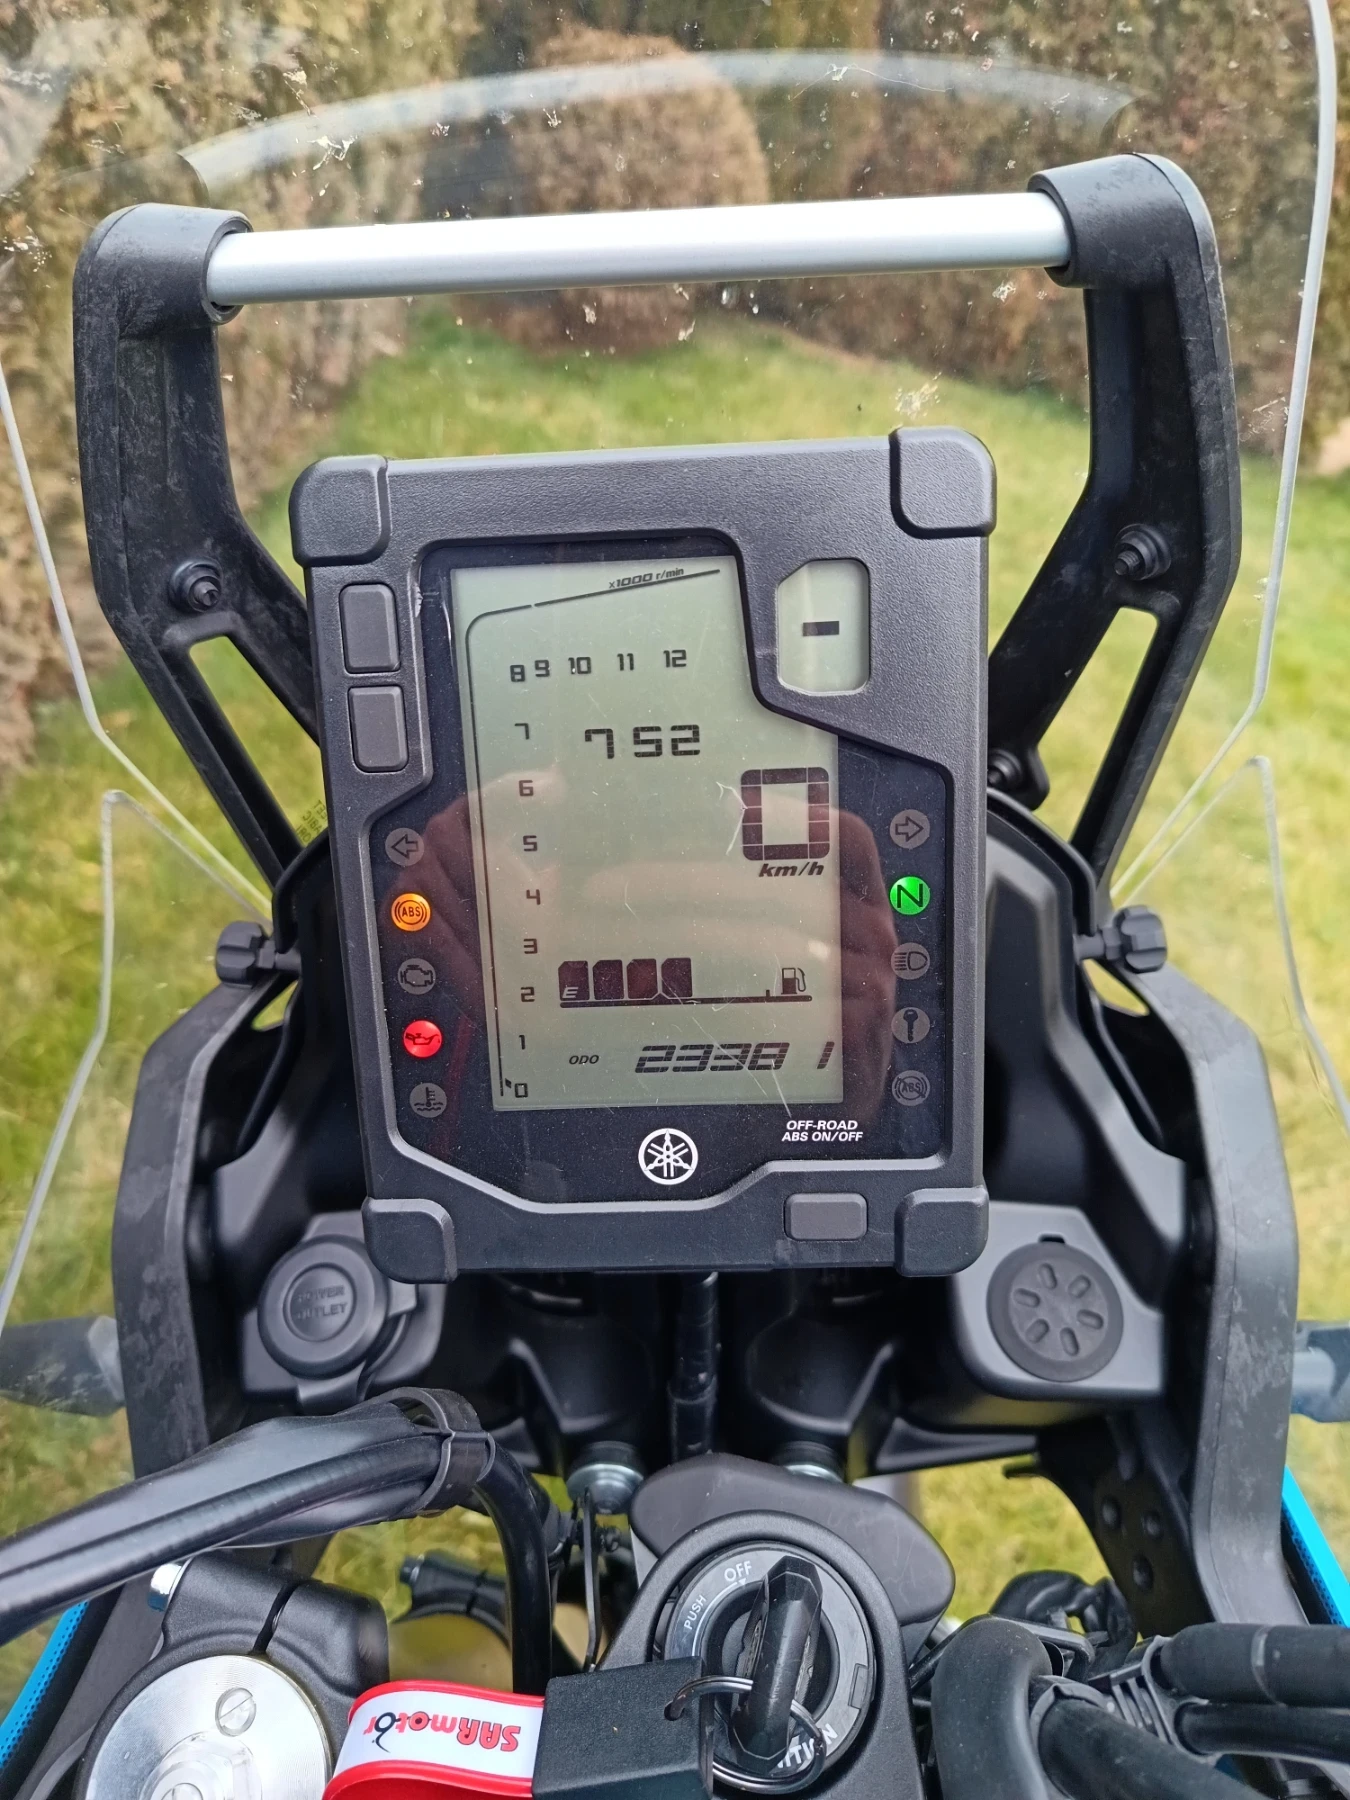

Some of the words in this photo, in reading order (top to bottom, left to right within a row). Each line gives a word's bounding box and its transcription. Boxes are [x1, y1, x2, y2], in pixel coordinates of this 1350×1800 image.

[655, 567, 684, 580] r/min
[510, 664, 526, 682] 8
[534, 659, 550, 678] 9
[568, 656, 592, 675] 10
[617, 652, 635, 671] 11
[663, 649, 687, 668] 12
[514, 722, 530, 740] 7
[519, 779, 534, 797] 6
[523, 835, 538, 852] 5
[758, 861, 825, 878] km/h
[526, 889, 541, 905] 4
[402, 905, 422, 918] ABS
[523, 938, 538, 955] 3
[520, 987, 535, 1003] 2
[519, 1034, 526, 1050] 1
[568, 1055, 599, 1065] ODO
[514, 1083, 528, 1099] 0
[786, 1120, 858, 1131] OFF-ROAD
[781, 1132, 808, 1142] ABS
[811, 1132, 863, 1142] ON/OFF
[724, 1561, 752, 1582] OFF
[683, 1594, 707, 1630] PUSH
